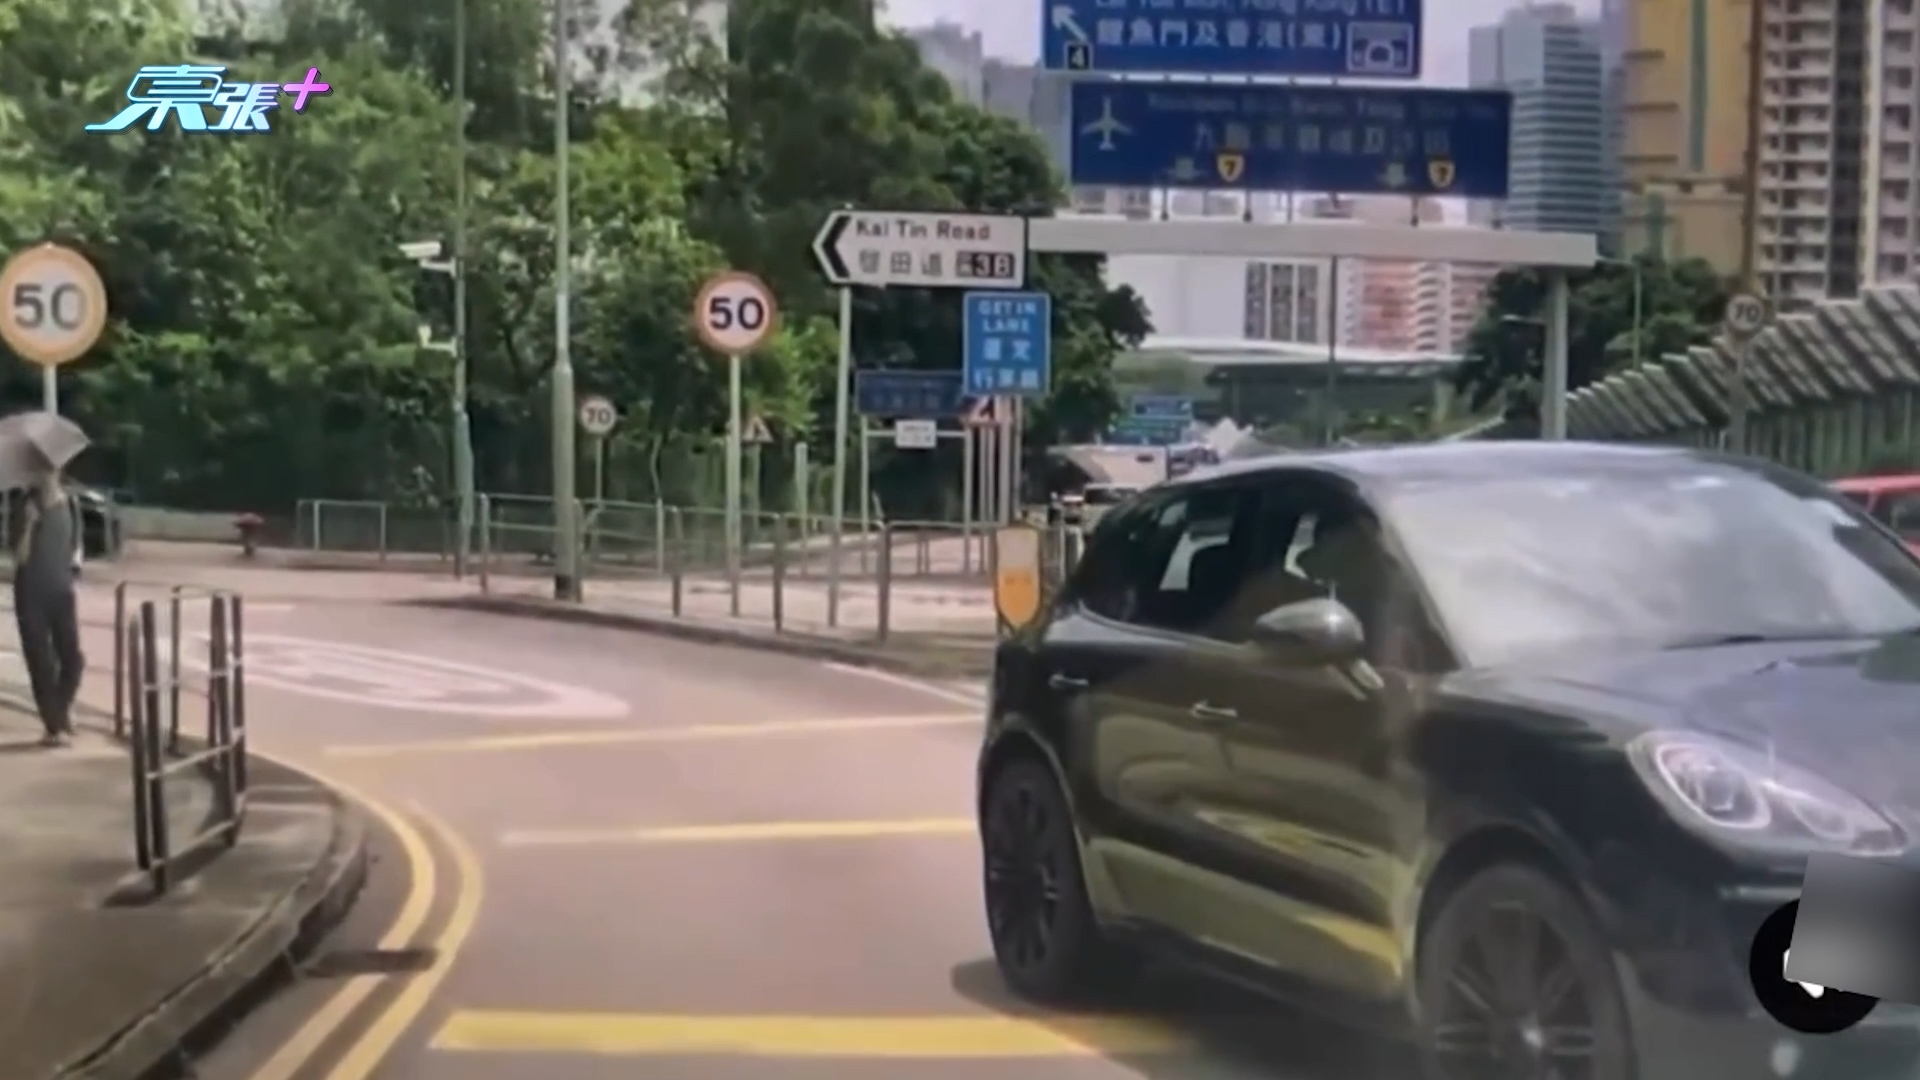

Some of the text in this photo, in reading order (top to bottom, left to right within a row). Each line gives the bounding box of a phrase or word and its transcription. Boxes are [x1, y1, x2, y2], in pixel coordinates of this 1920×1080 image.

[1225, 160, 1237, 177] 7
[897, 220, 929, 238] Tin
[937, 220, 991, 240] Road
[14, 283, 88, 331] 50
[710, 297, 764, 331] 50
[1735, 303, 1761, 324] 70
[586, 406, 611, 425] 70
